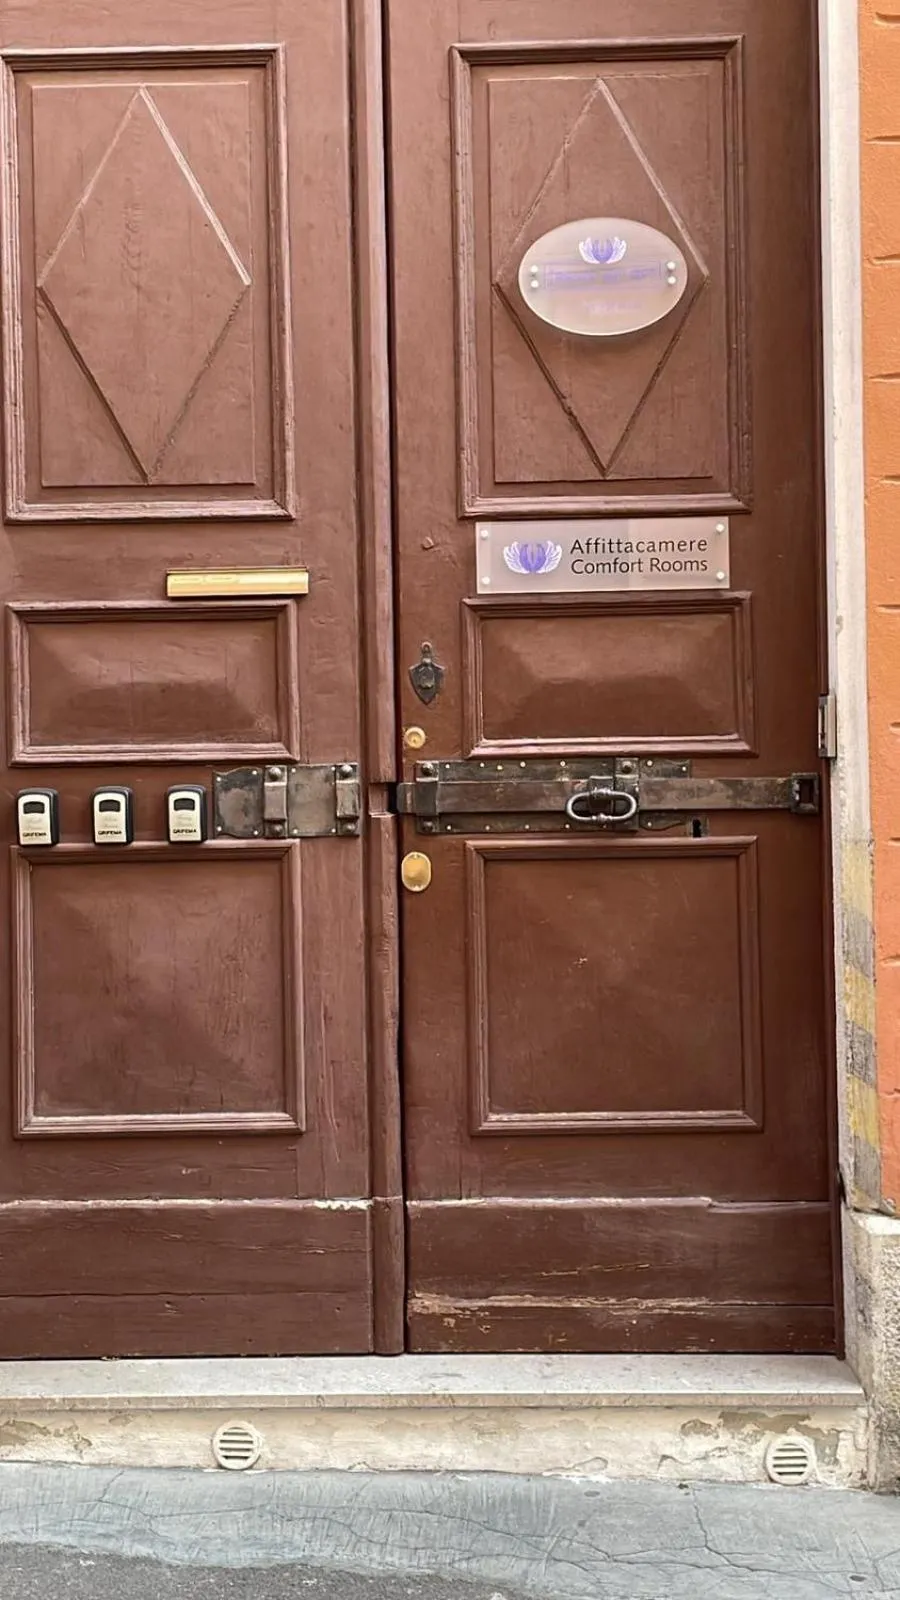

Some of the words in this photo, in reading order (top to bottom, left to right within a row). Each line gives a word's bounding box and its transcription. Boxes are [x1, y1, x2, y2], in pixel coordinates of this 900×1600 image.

[570, 537, 708, 554] Affittacamere
[571, 557, 643, 574] Comfort
[649, 557, 708, 573] Rooms
